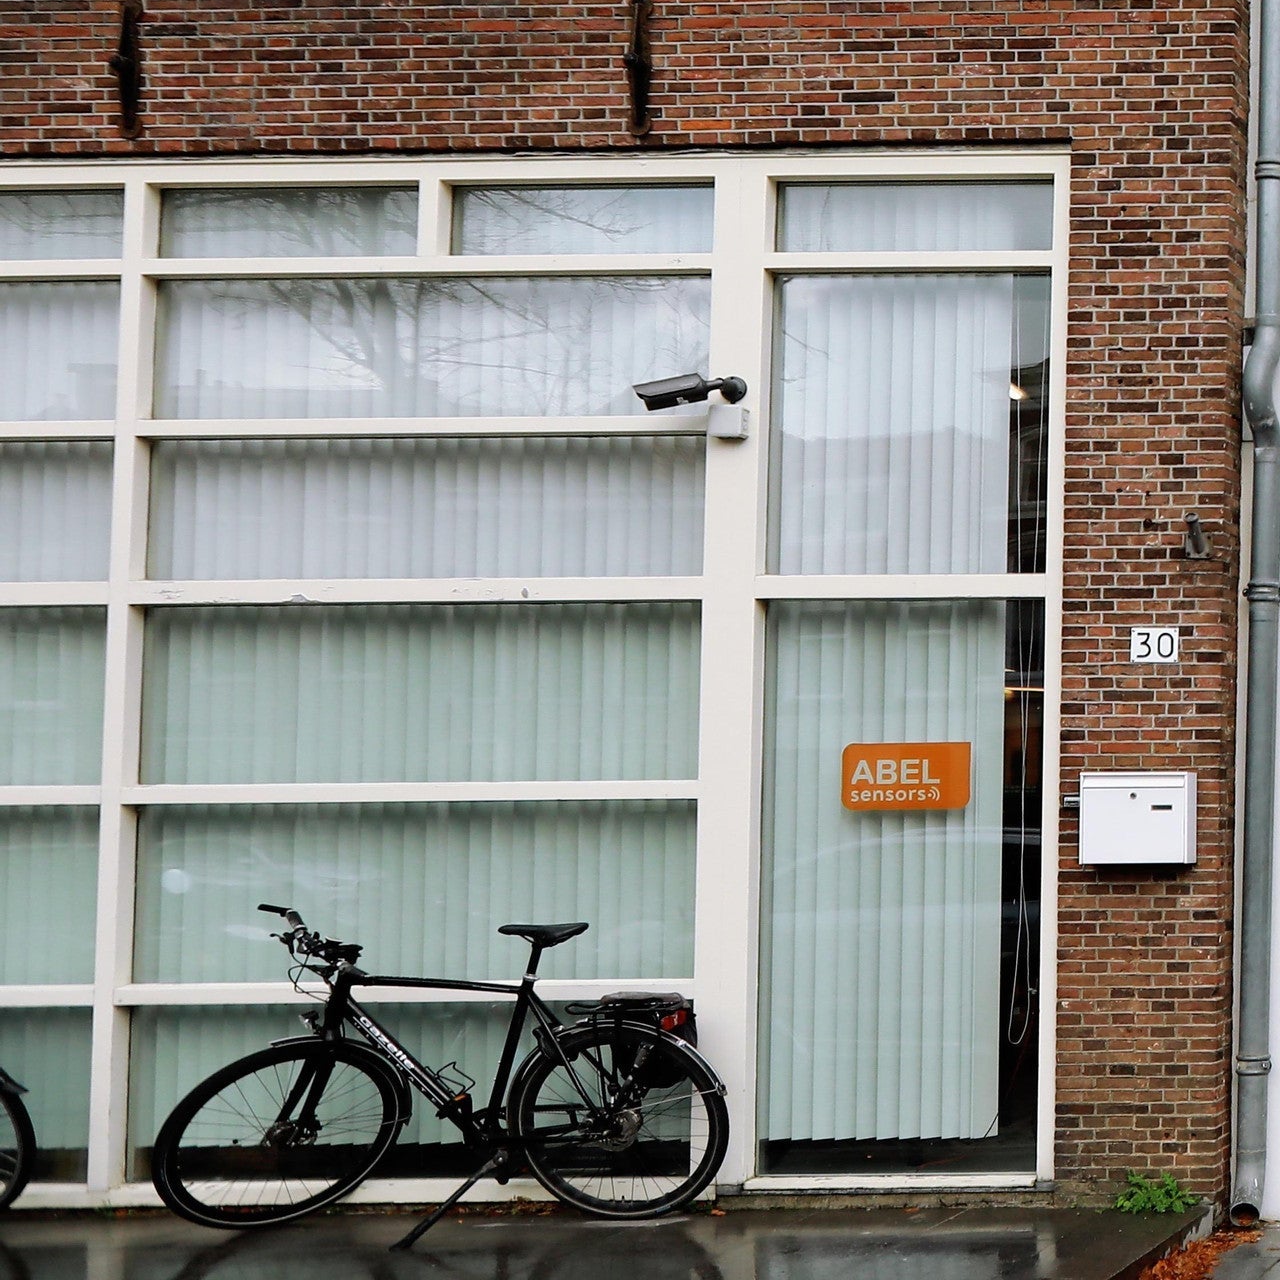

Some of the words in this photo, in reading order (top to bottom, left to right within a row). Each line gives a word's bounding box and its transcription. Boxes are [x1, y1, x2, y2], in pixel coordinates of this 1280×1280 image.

[1136, 632, 1174, 658] 30
[850, 759, 940, 785] ABEL
[850, 788, 926, 802] sensors
[359, 1016, 416, 1069] Gazelle
